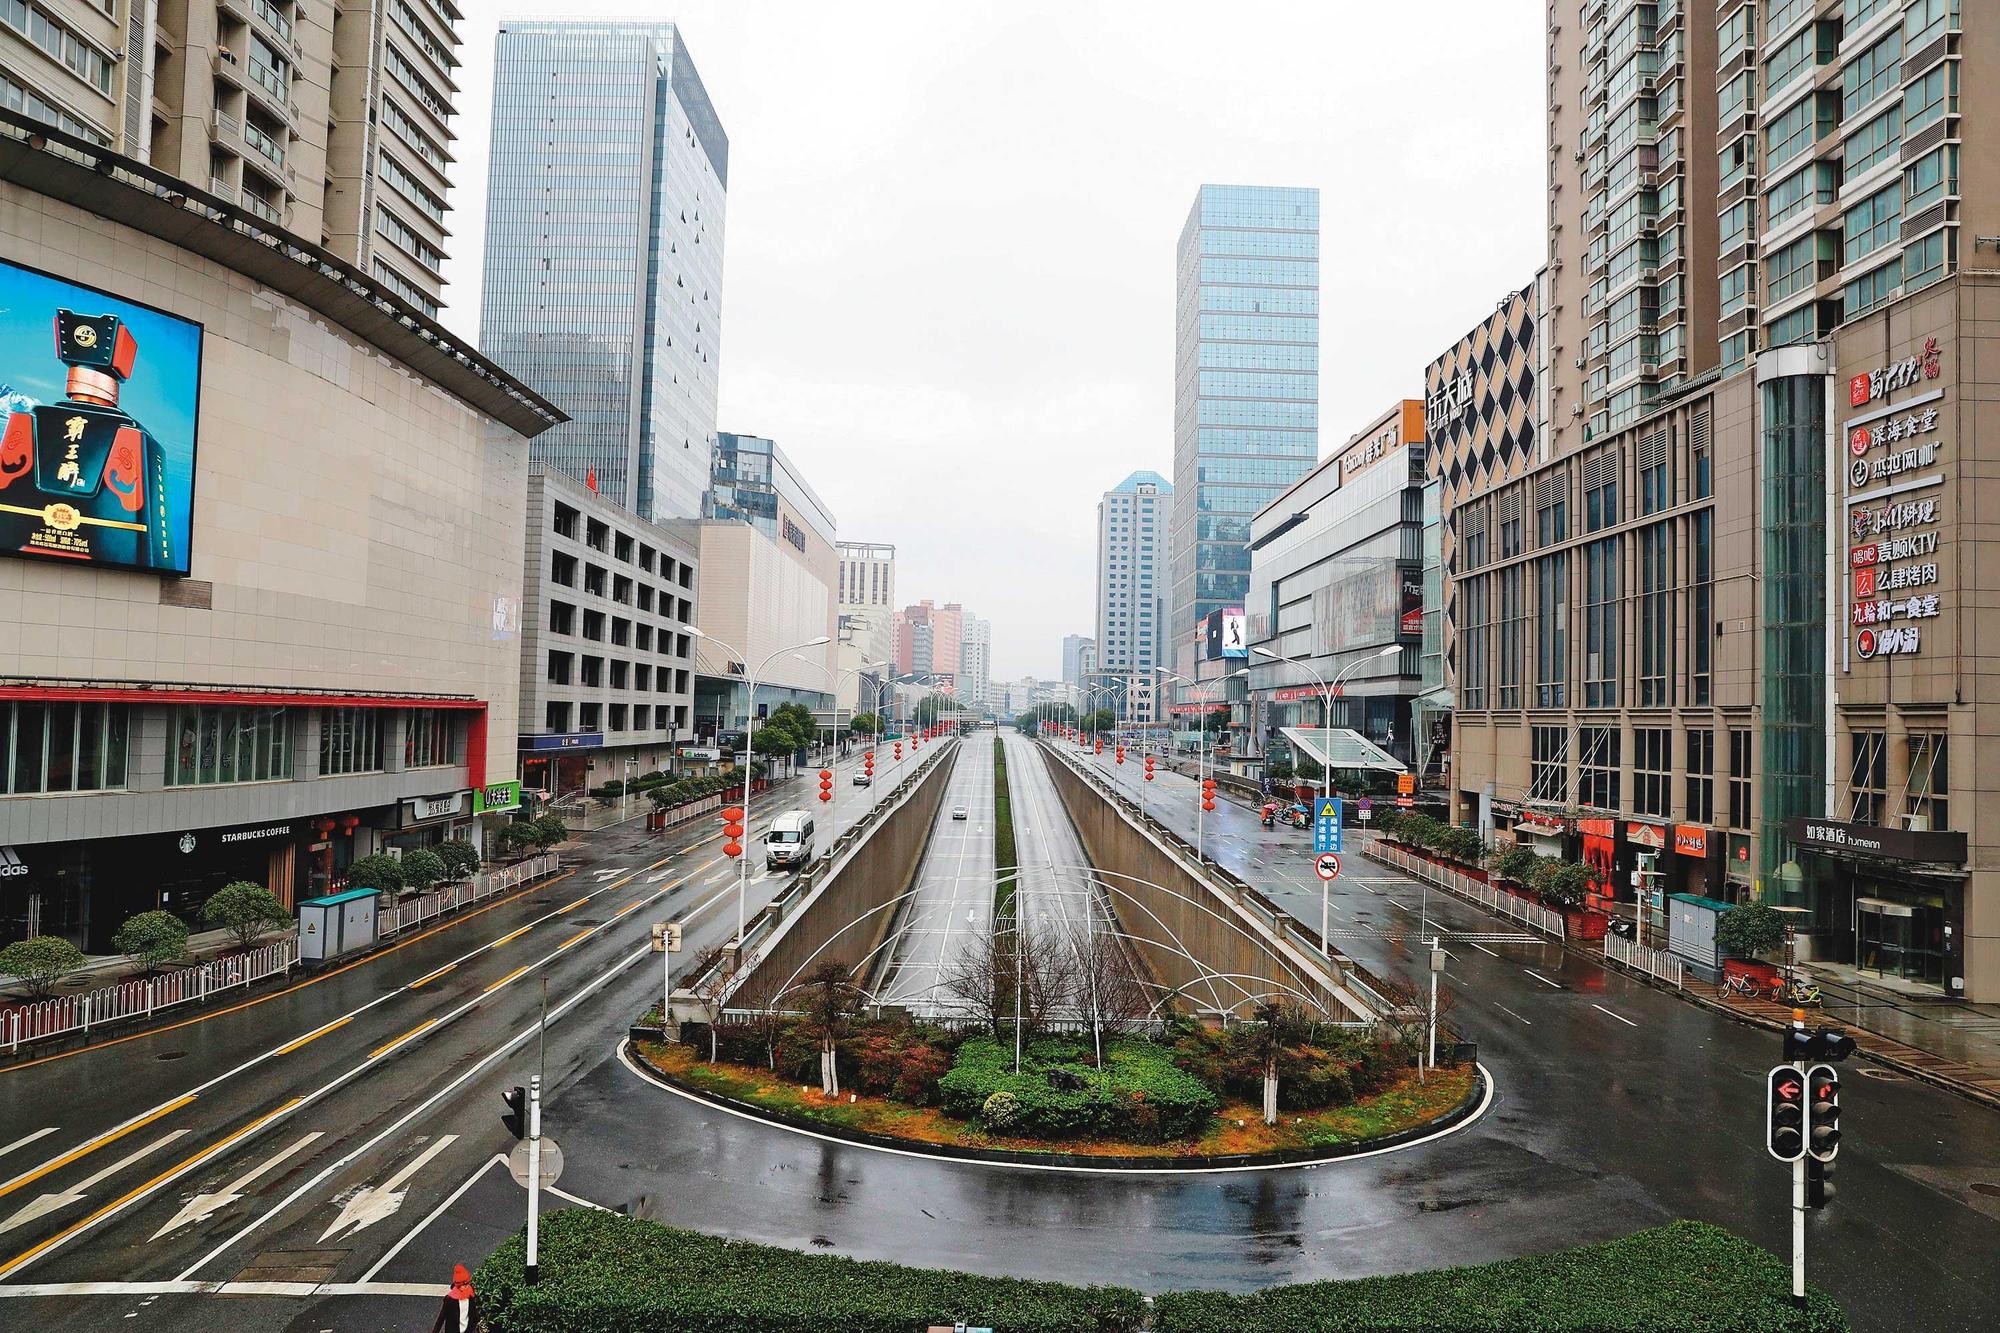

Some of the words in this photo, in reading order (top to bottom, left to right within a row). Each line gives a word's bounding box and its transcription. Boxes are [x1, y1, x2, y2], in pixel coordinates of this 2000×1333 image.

[1872, 409, 1937, 446] 深海食堂
[1872, 444, 1934, 478] 杰拉网咖
[1873, 500, 1934, 534] 小川料理
[222, 830, 265, 842] STARBUCKS
[266, 826, 290, 837] COFFEE
[1806, 824, 1846, 844] 如家酒店
